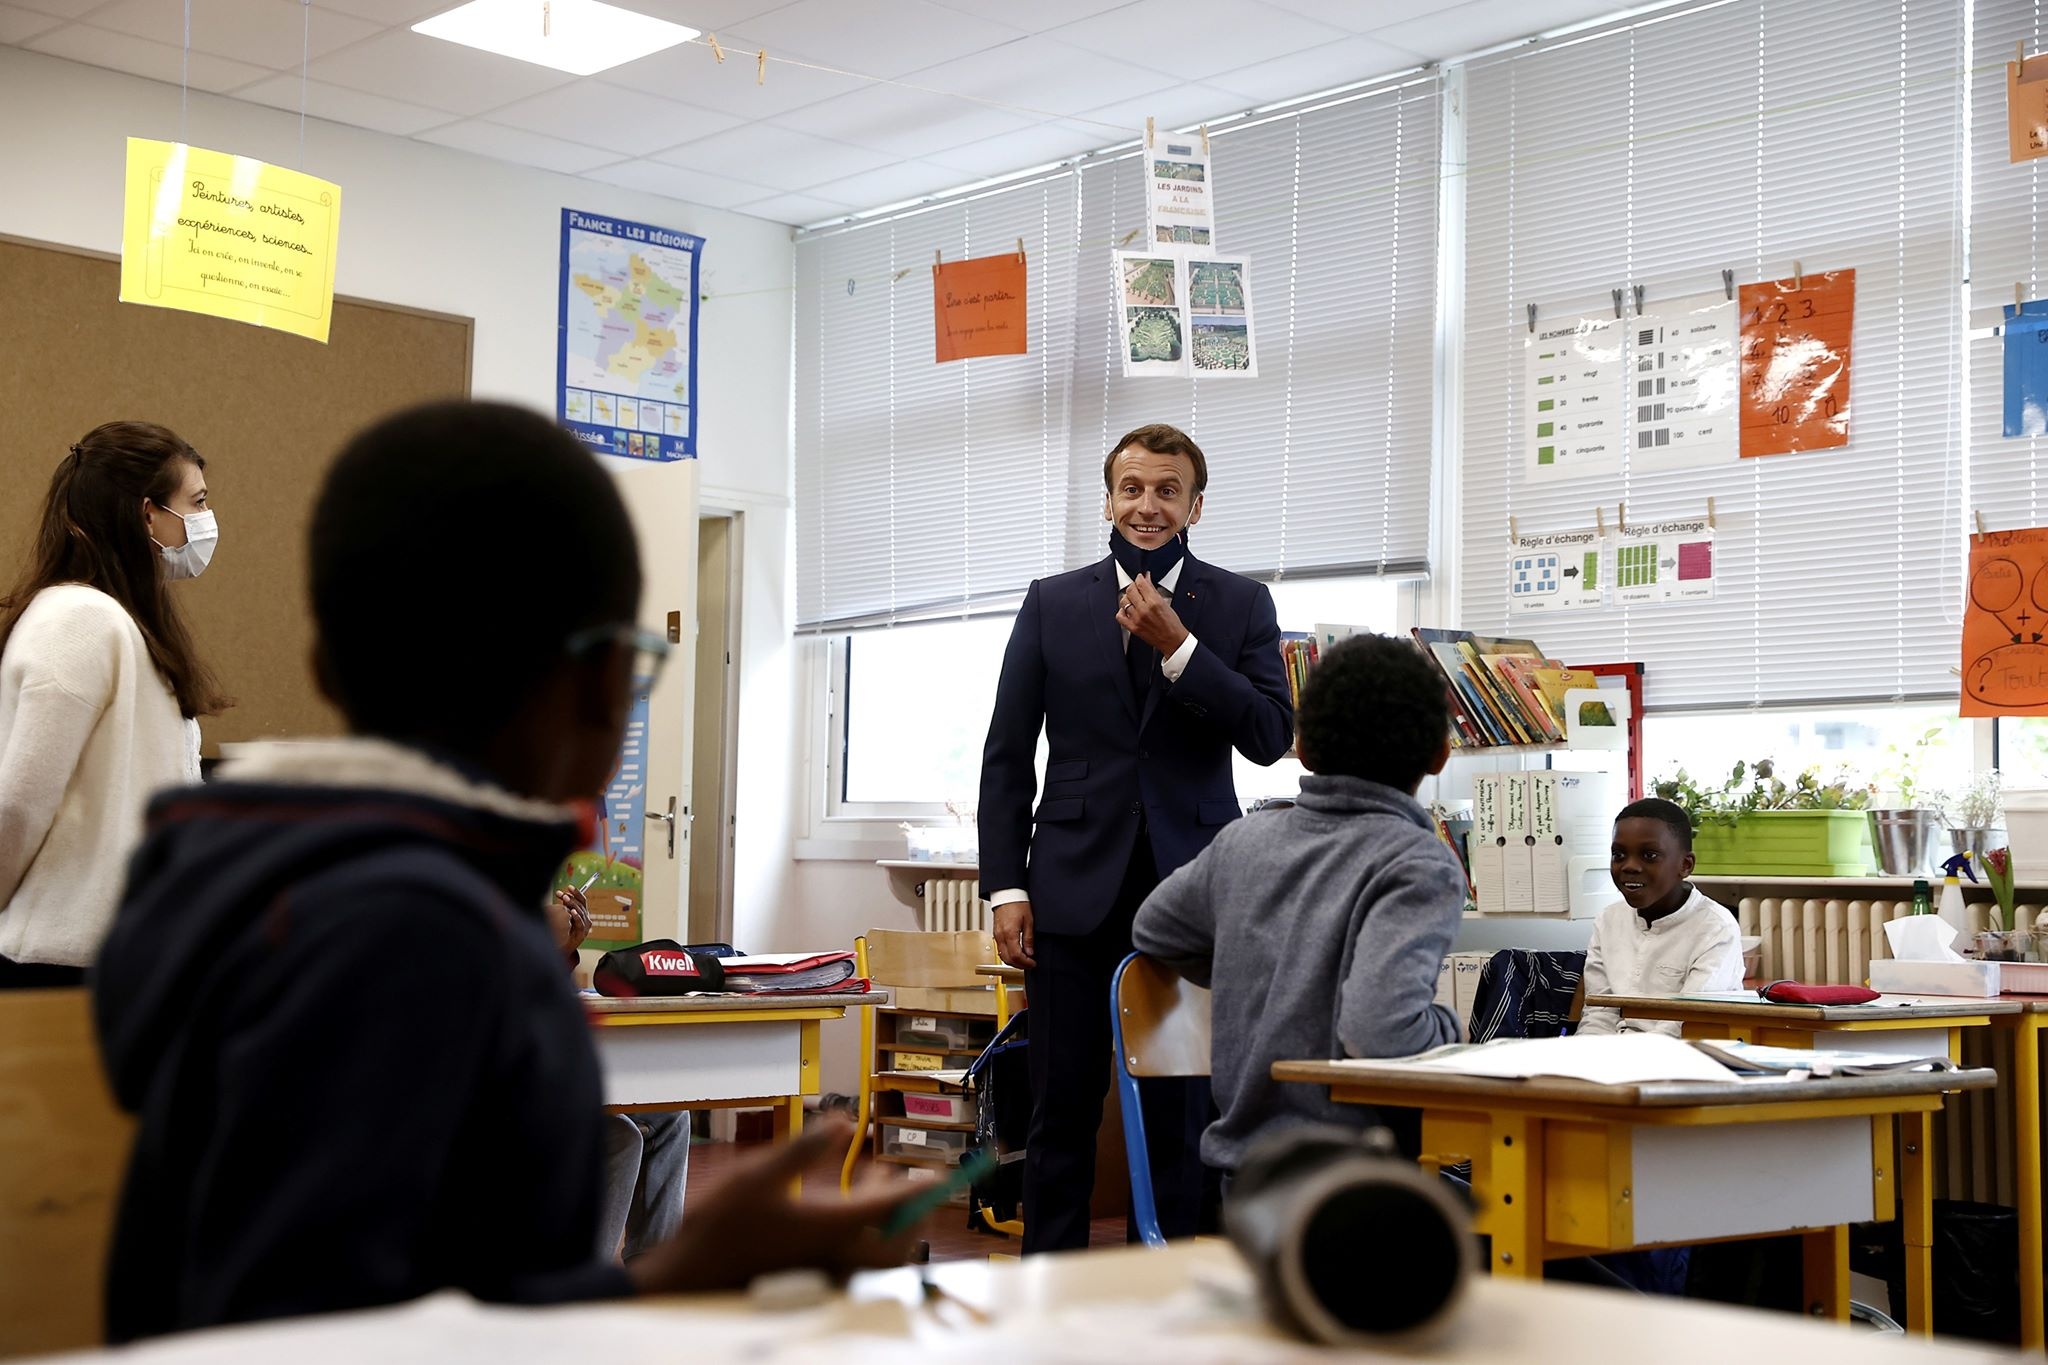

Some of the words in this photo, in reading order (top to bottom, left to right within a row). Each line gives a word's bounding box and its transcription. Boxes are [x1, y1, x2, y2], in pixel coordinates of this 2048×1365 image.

[1157, 183, 1171, 191] LES
[1173, 184, 1203, 194] JARDINS
[192, 181, 254, 212] Peintures,
[259, 203, 305, 226] artistes,
[177, 218, 257, 243] expériences,
[649, 230, 695, 250] RÉGIONS
[239, 256, 250, 264] on
[284, 268, 294, 276] on
[249, 282, 260, 290] on
[1752, 306, 1762, 325] 1
[1777, 302, 1790, 322] 2
[1800, 299, 1813, 318] 3
[1772, 405, 1790, 424] 10
[1698, 428, 1713, 436] cent
[1652, 522, 1705, 534] d'échange
[1519, 537, 1544, 549] Règle
[1545, 533, 1594, 545] d'échange
[1569, 778, 1580, 786] TOP
[648, 953, 695, 971] Kwell
[906, 1132, 917, 1142] CP
